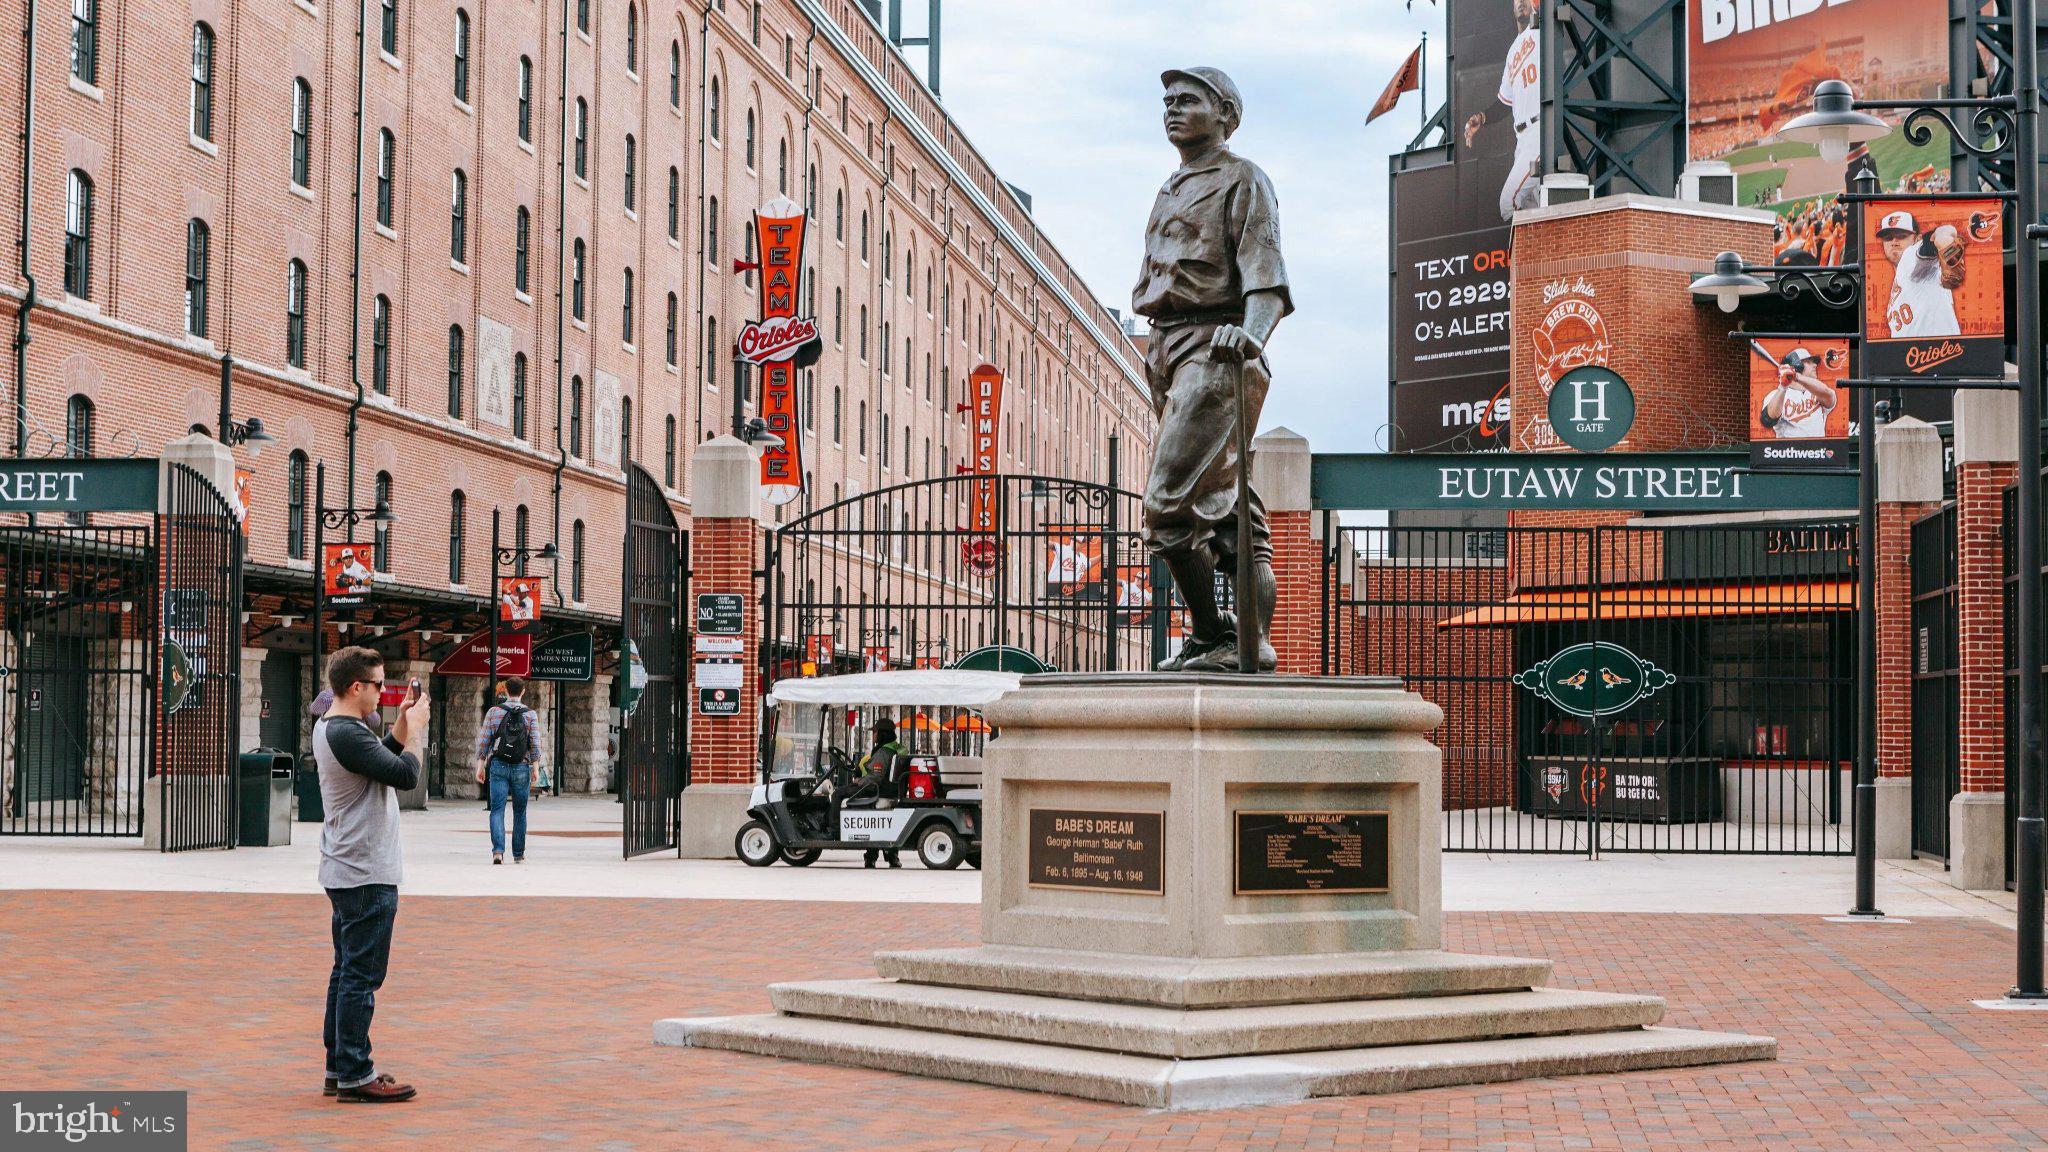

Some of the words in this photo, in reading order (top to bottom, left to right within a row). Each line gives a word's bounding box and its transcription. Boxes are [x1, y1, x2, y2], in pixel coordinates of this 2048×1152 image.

[1522, 64, 1537, 88] 10
[768, 225, 791, 310] TEAM
[1415, 255, 1468, 280] TEXT
[1415, 290, 1442, 310] TO
[1543, 277, 1569, 304] Slide
[1572, 276, 1596, 297] Into
[1546, 303, 1576, 328] BREW
[1579, 305, 1598, 325] PUB
[741, 320, 815, 358] Orioles
[1415, 321, 1443, 341] O's
[1906, 341, 1964, 371] Orioles
[1569, 381, 1611, 421] H
[766, 368, 790, 476] STORE
[1576, 423, 1604, 433] GATE
[1764, 447, 1825, 459] Southwest
[1438, 468, 1583, 499] EUTAW
[1595, 467, 1747, 499] STREET
[700, 607, 714, 619] NO
[471, 645, 489, 653] Bank
[496, 646, 526, 655] America
[843, 817, 893, 829] SECURITY
[1055, 818, 1093, 833] BABE'S
[1096, 820, 1134, 835] DREAM
[1046, 835, 1071, 849] George
[1073, 838, 1100, 849] Herman
[1126, 840, 1144, 851] Ruth
[1073, 852, 1115, 864] Baltimorean
[1045, 866, 1060, 877] Feb.
[1062, 867, 1069, 878] 6,
[1071, 868, 1088, 878] 1895
[1095, 868, 1111, 882] Aug.
[1113, 870, 1124, 882] 16,
[1126, 871, 1143, 882] 1948
